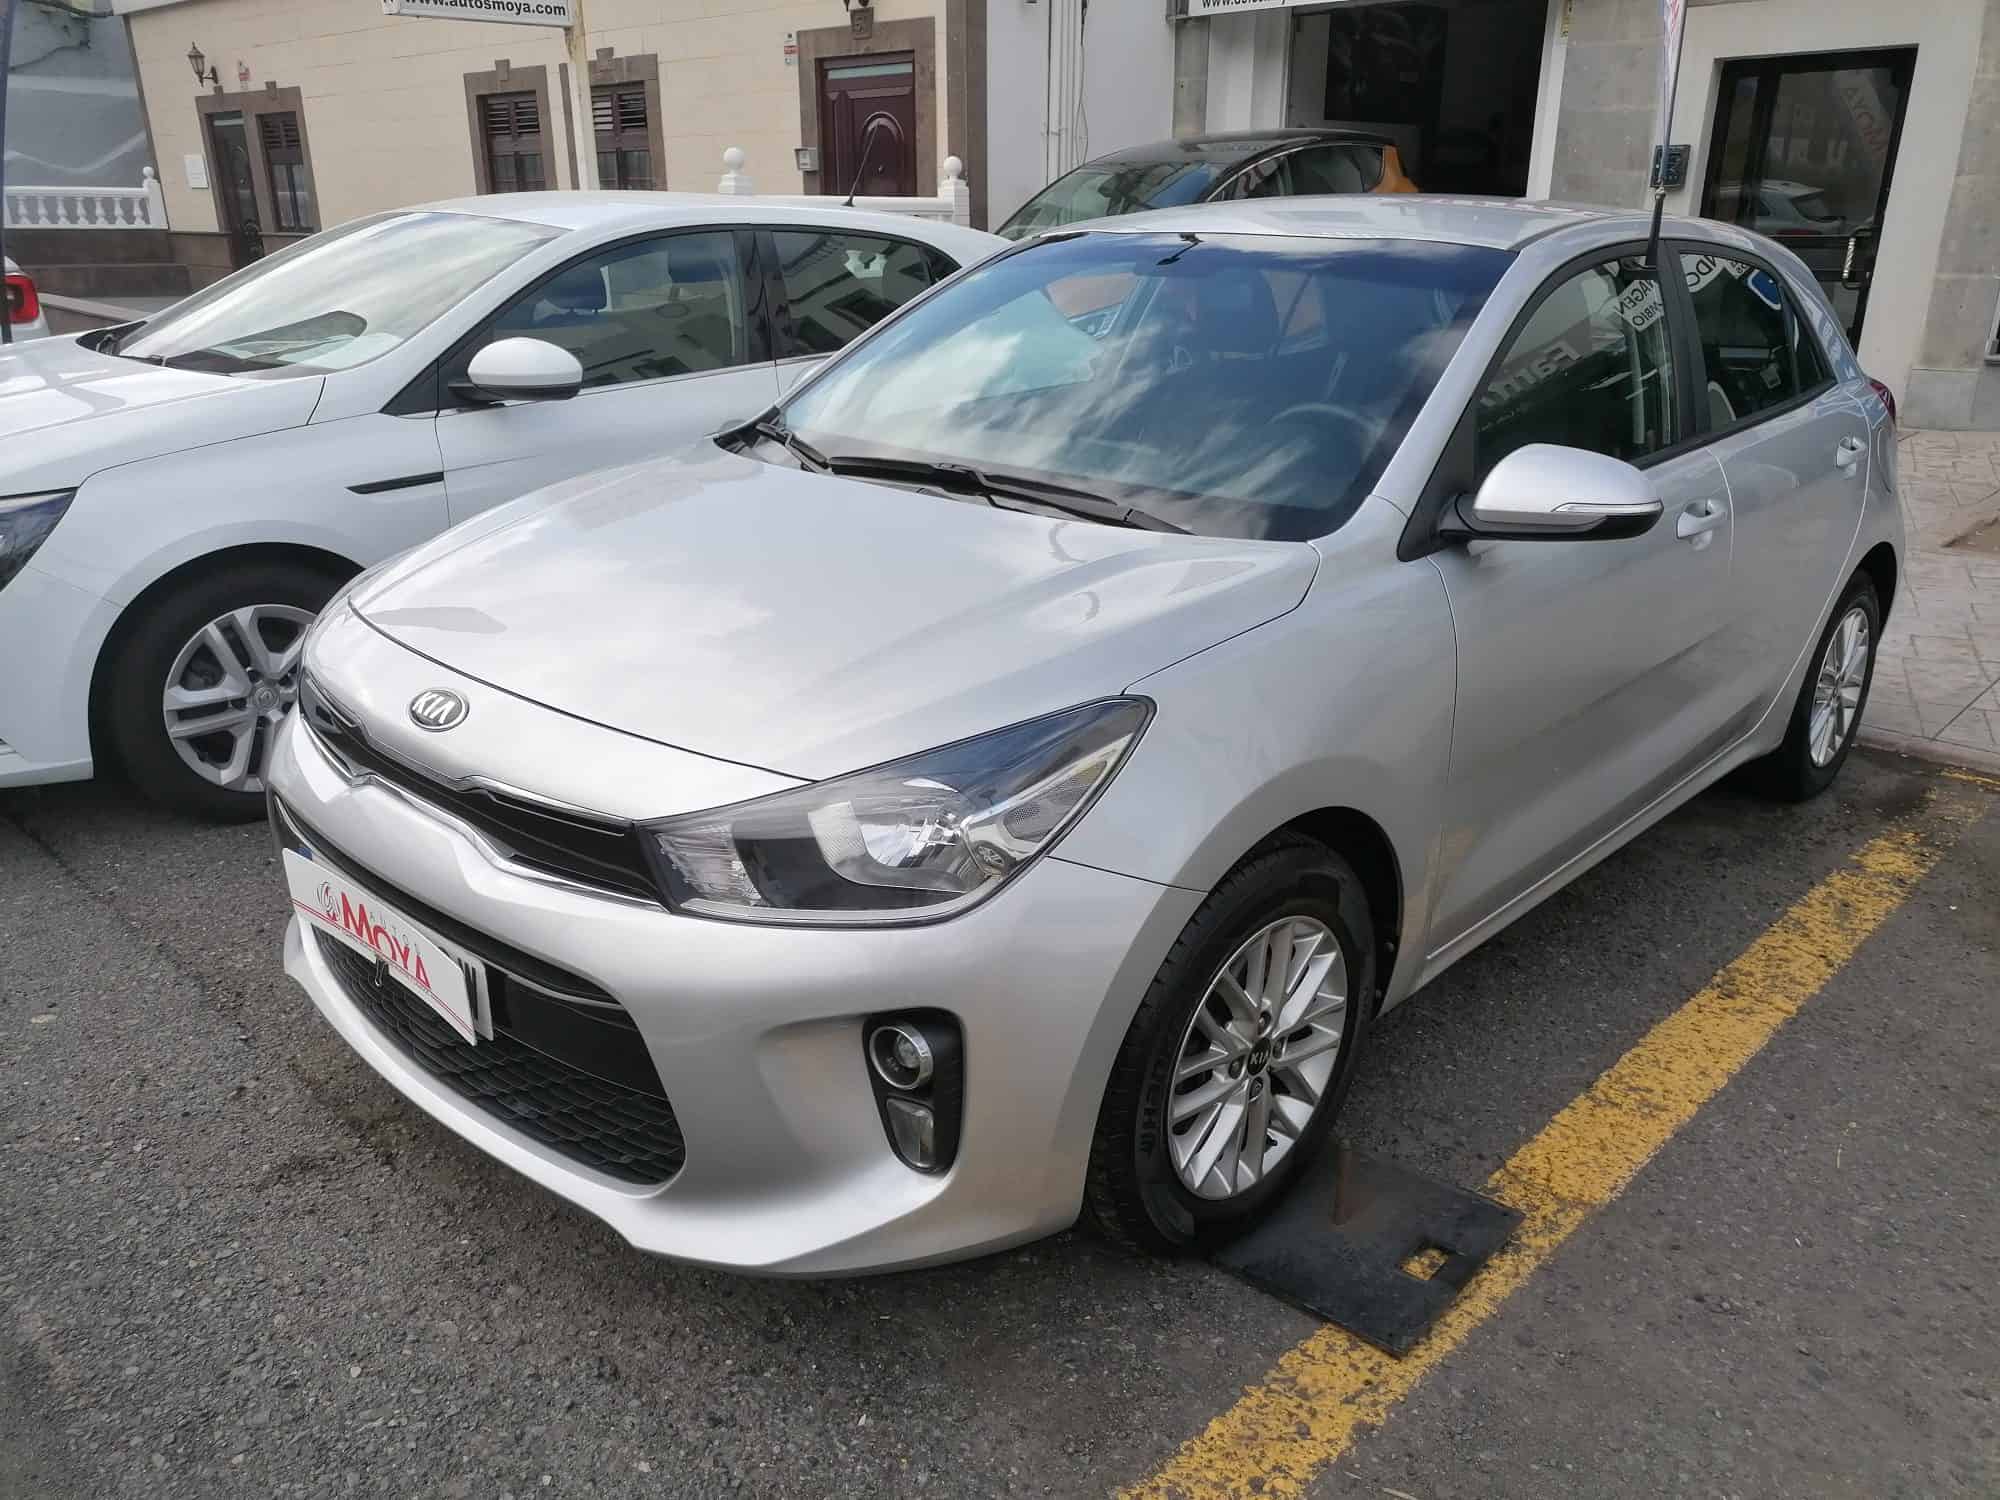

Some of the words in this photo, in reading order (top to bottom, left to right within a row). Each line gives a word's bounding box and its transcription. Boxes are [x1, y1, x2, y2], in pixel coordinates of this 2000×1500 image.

[406, 0, 566, 16] .autosmoya.com
[412, 692, 456, 724] KIA
[341, 892, 432, 990] MOYA
[1250, 1050, 1270, 1064] KIA
